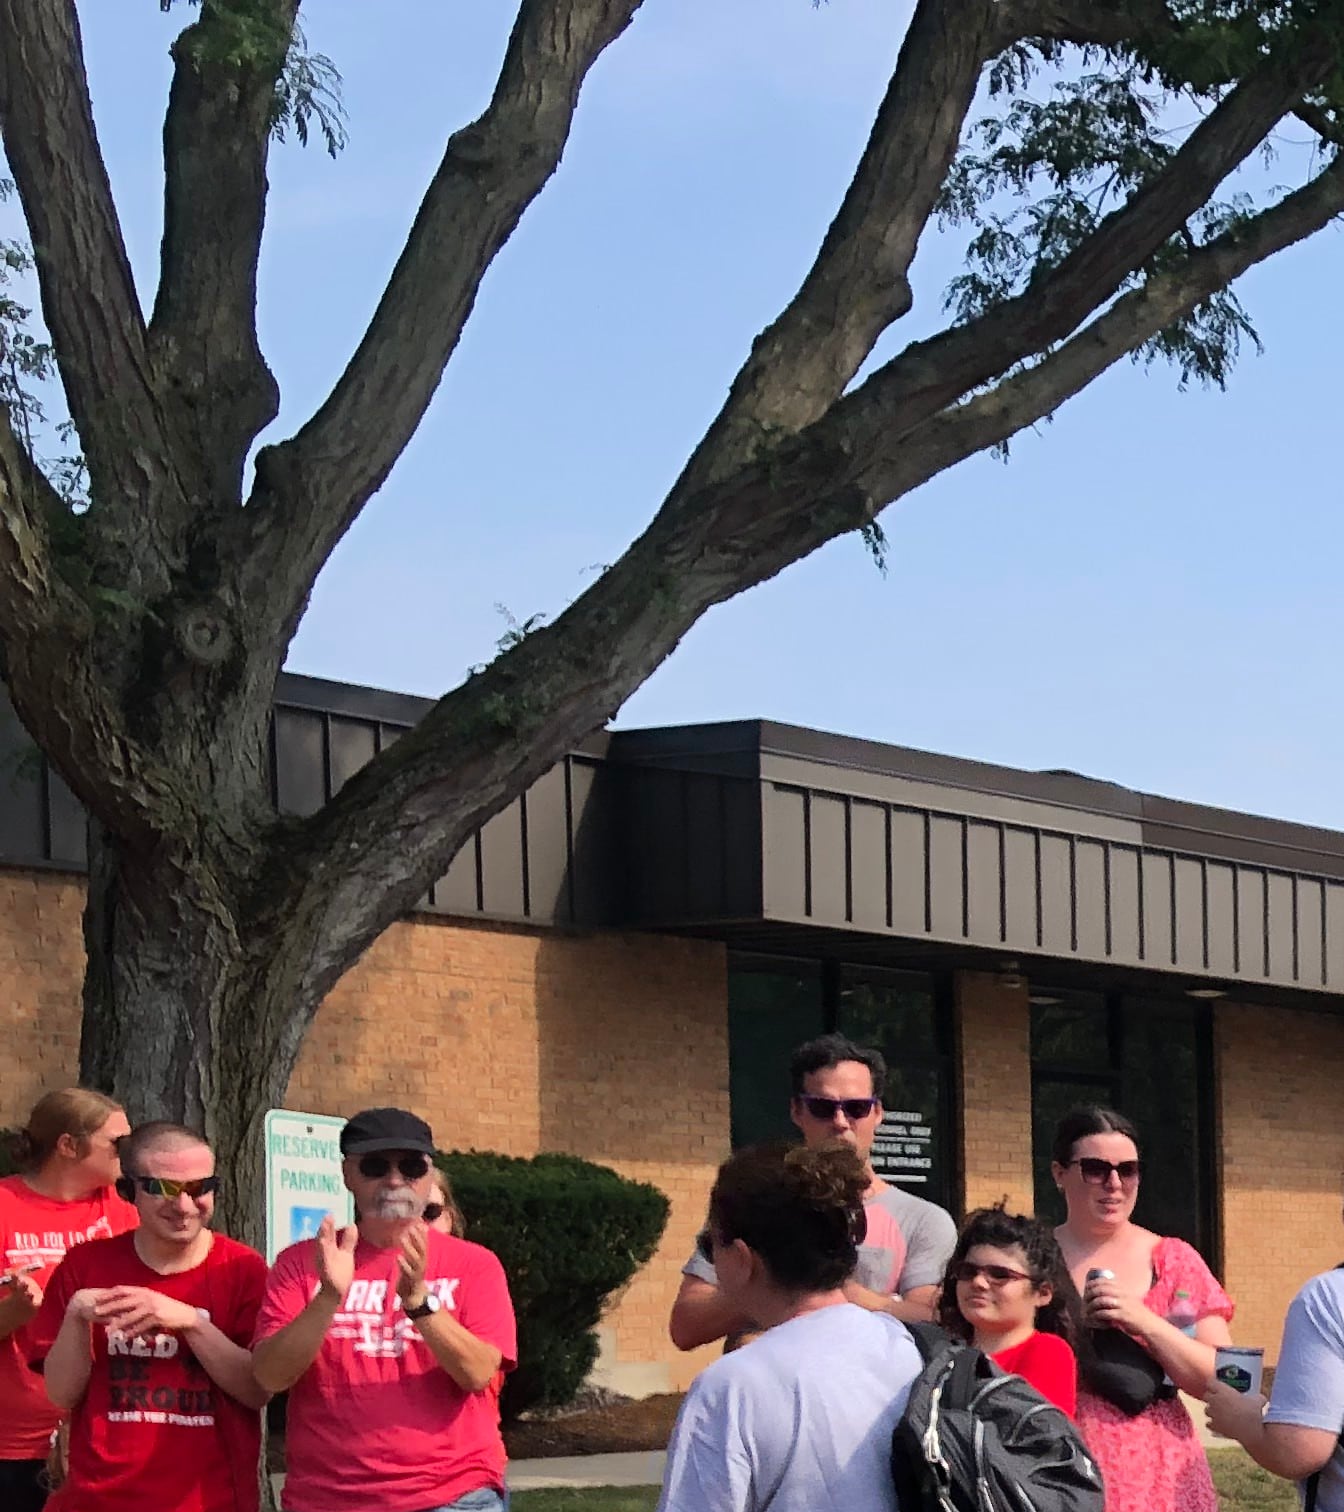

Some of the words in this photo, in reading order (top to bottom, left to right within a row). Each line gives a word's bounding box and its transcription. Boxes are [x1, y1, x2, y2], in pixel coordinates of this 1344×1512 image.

[270, 1134, 341, 1160] RESERVE
[281, 1168, 341, 1194] PARKING
[106, 1327, 178, 1359] RED
[109, 1384, 215, 1413] PROUD
